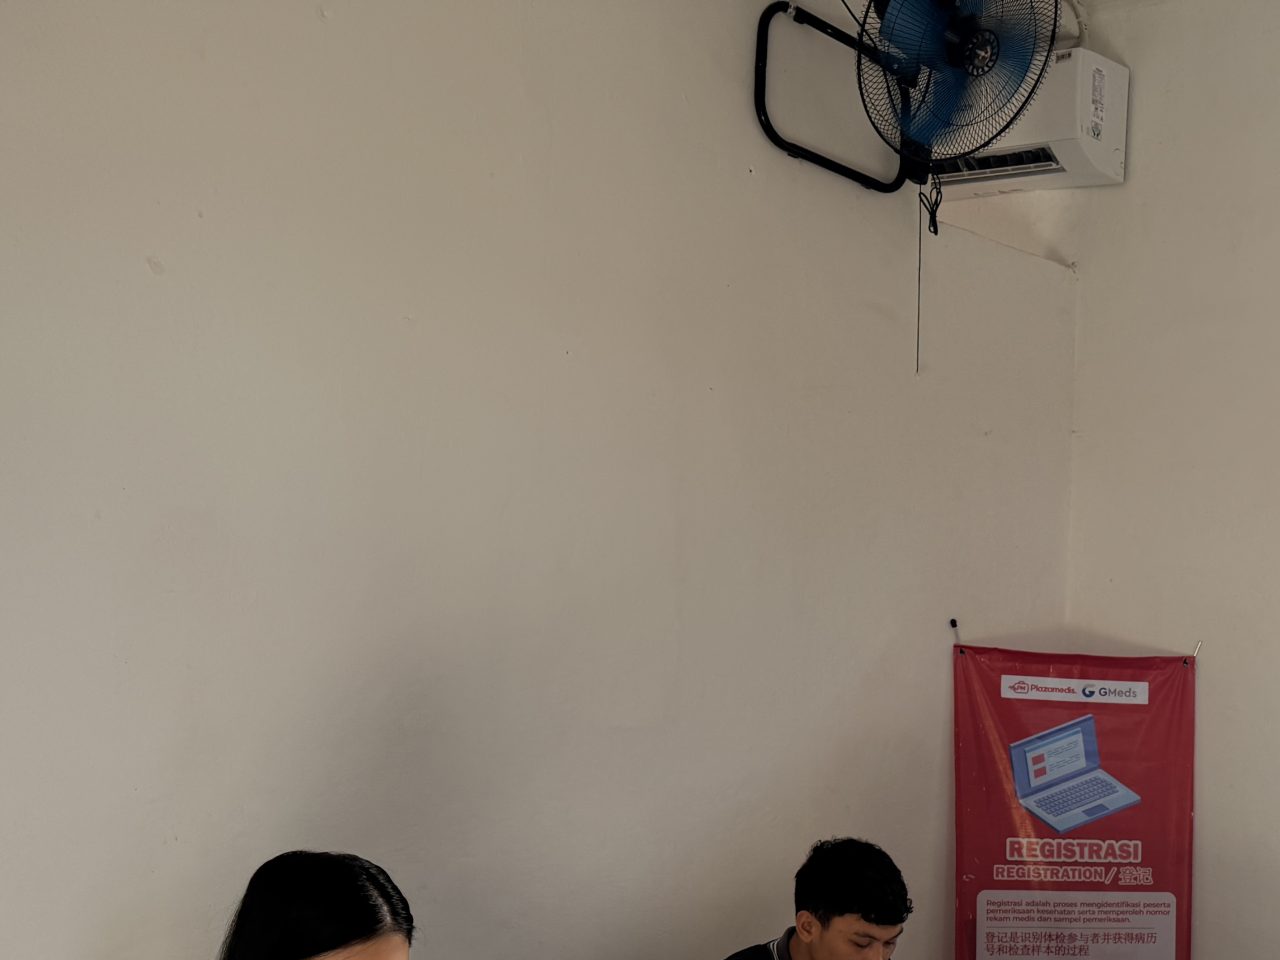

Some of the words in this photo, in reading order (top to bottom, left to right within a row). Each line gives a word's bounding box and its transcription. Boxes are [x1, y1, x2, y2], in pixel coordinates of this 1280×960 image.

[1098, 687, 1137, 698] GMeds
[1007, 839, 1140, 862] REGISTRASI
[986, 899, 1023, 908] Registrasi
[1025, 900, 1051, 908] adalah
[1053, 901, 1078, 909] proses
[1080, 901, 1141, 910] mengidentifikasi
[1143, 902, 1171, 910] peserta
[986, 907, 1035, 916] pemeriksaan
[1037, 908, 1075, 916] kesehatan
[1097, 909, 1144, 917] memperoleh
[1012, 915, 1036, 923] medis
[1053, 916, 1081, 924] sampel
[1082, 916, 1131, 924] pemeriksaan.
